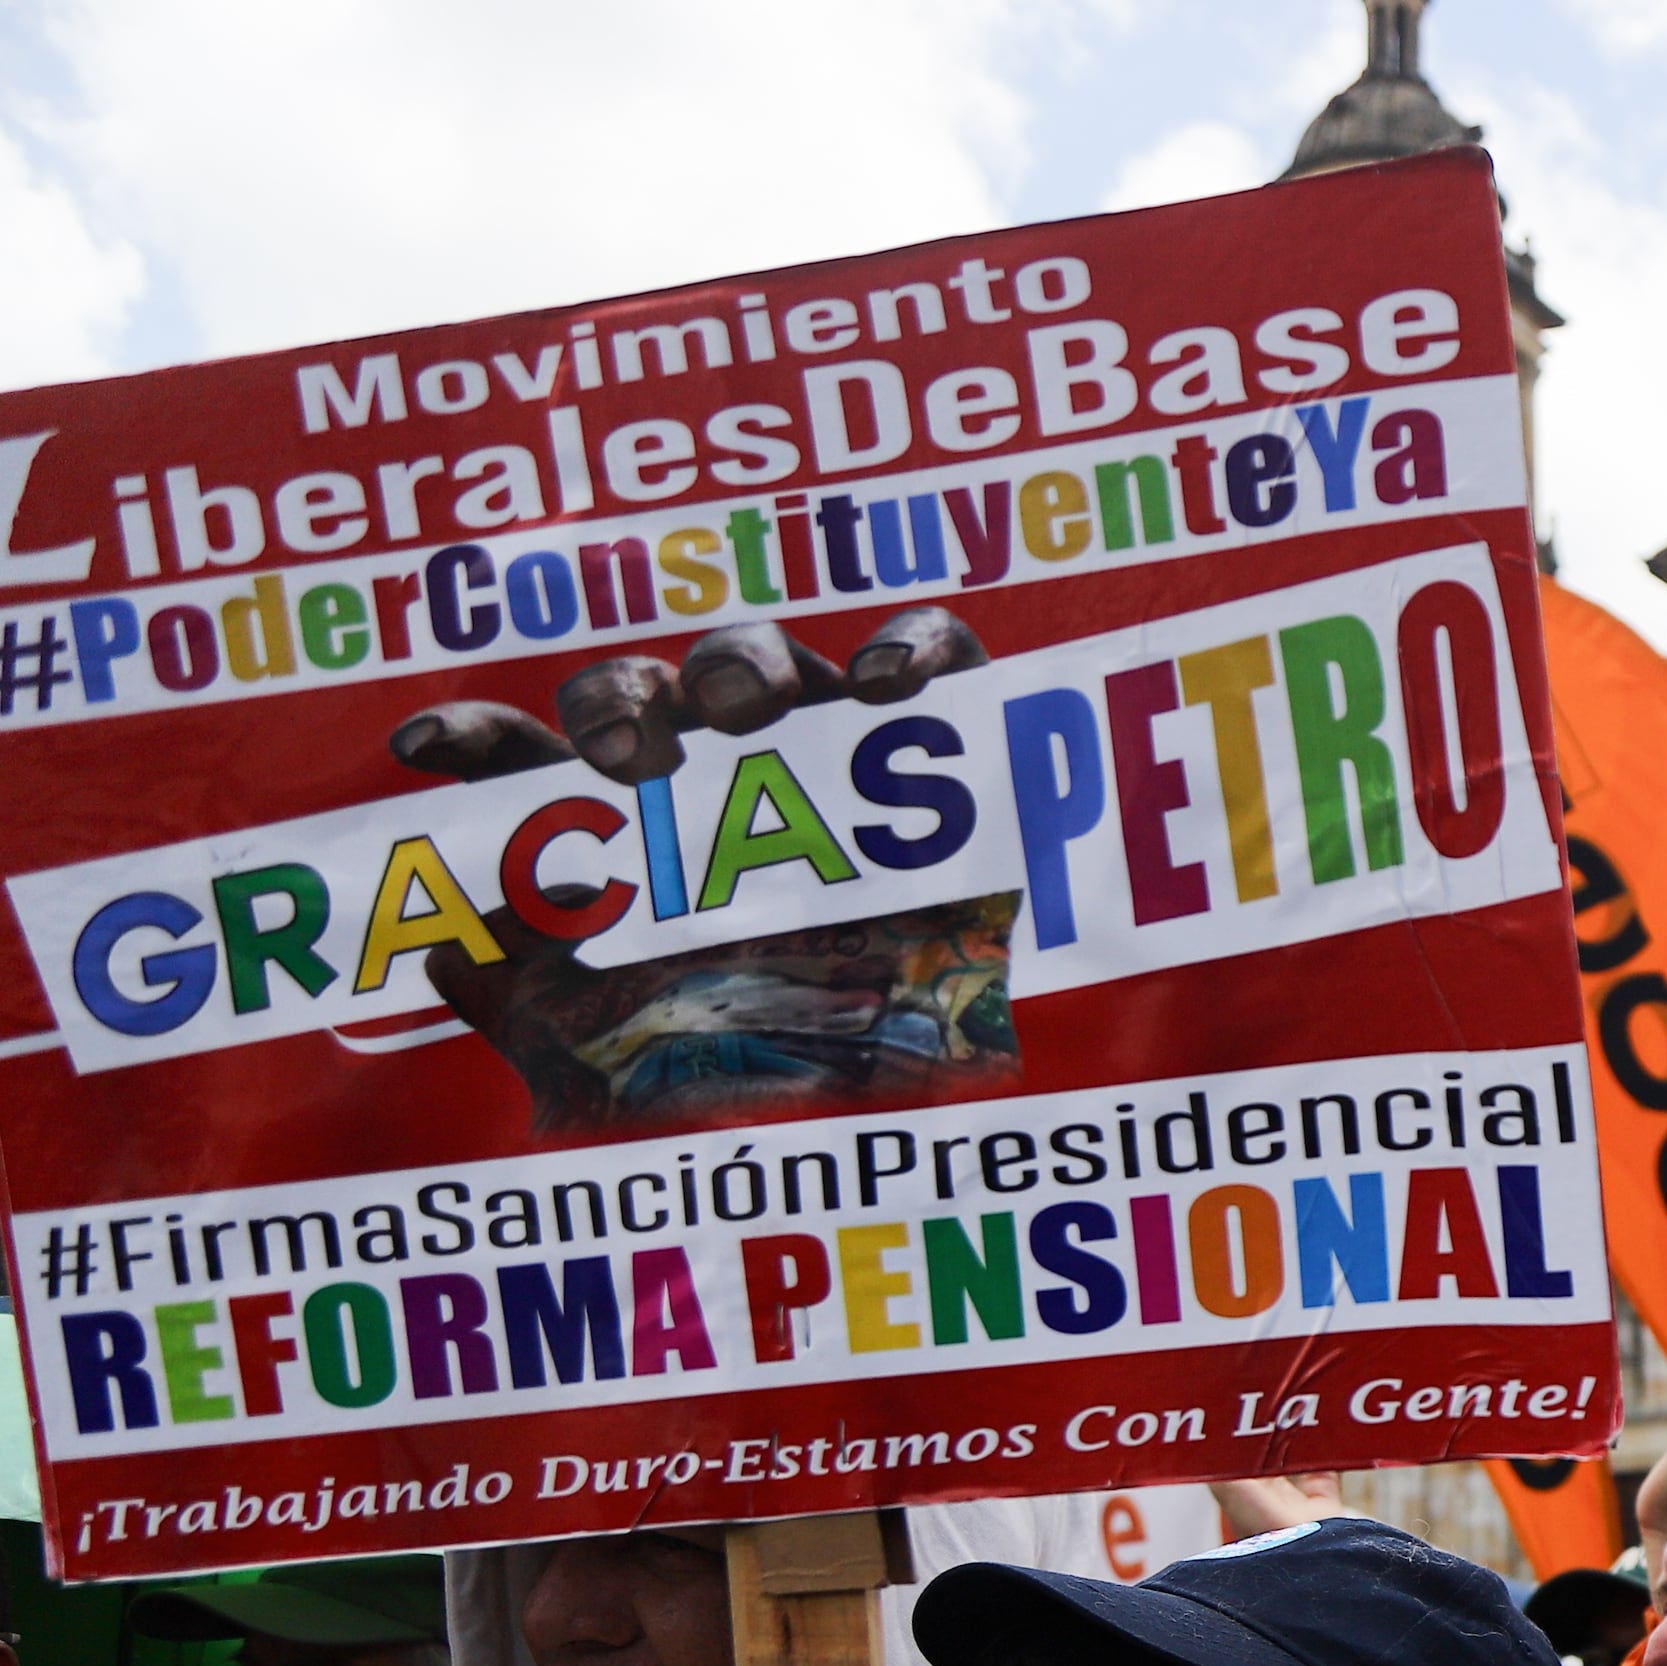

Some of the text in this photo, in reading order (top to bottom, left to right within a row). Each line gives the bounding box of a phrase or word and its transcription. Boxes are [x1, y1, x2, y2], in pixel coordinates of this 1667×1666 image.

[0, 287, 1461, 582] LiberalesDeBase
[296, 256, 1092, 434] Movimiento
[0, 397, 1447, 714] #PoderConstituyenteYa
[72, 579, 1506, 1037] GRACIAS PETRO
[41, 1062, 1577, 1299] #FirmaSanciónPresidencial
[60, 1165, 1573, 1435] REFORMA PENSIONAL
[77, 1376, 1596, 1553] ¡Trabajando Duro-Estamos Con La Gente!
